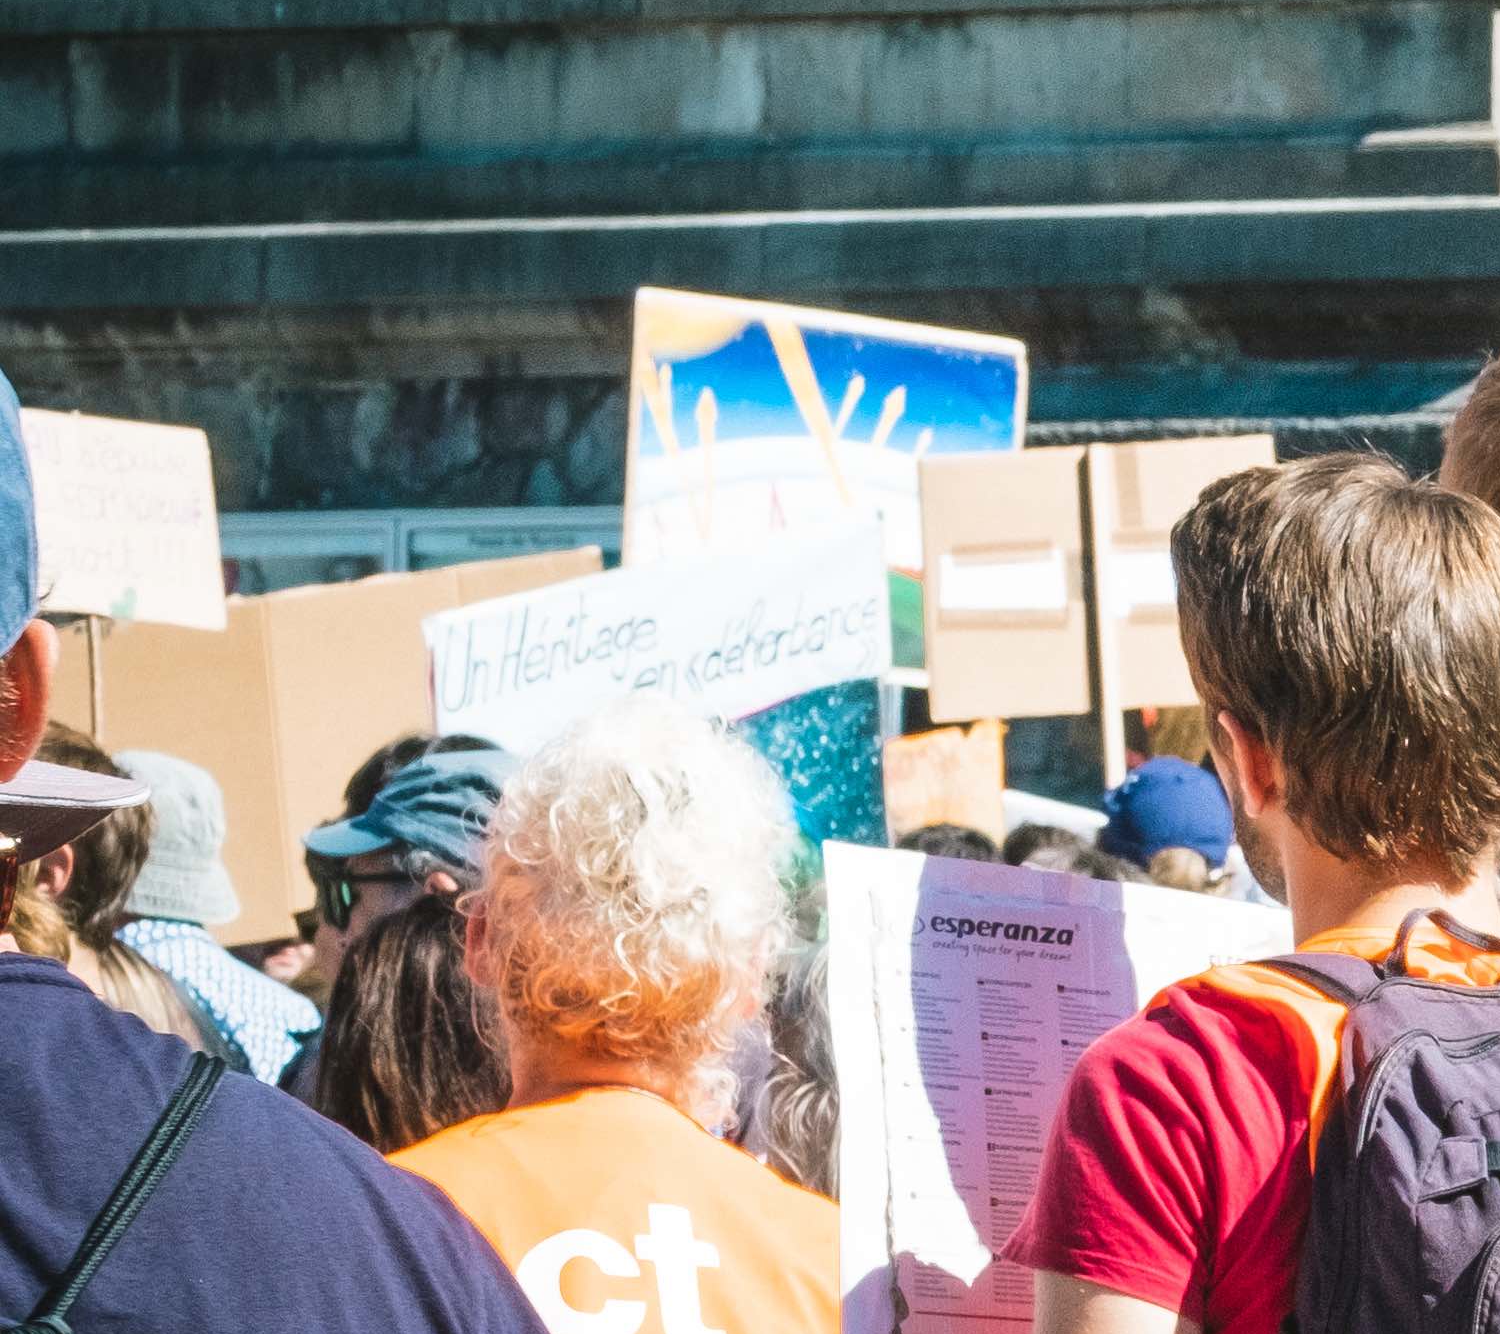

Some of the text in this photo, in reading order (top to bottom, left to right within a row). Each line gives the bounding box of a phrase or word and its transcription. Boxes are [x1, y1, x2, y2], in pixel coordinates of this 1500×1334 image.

[442, 593, 660, 712] Un Héritage
[631, 662, 677, 698] en
[930, 914, 1074, 947] esperanza
